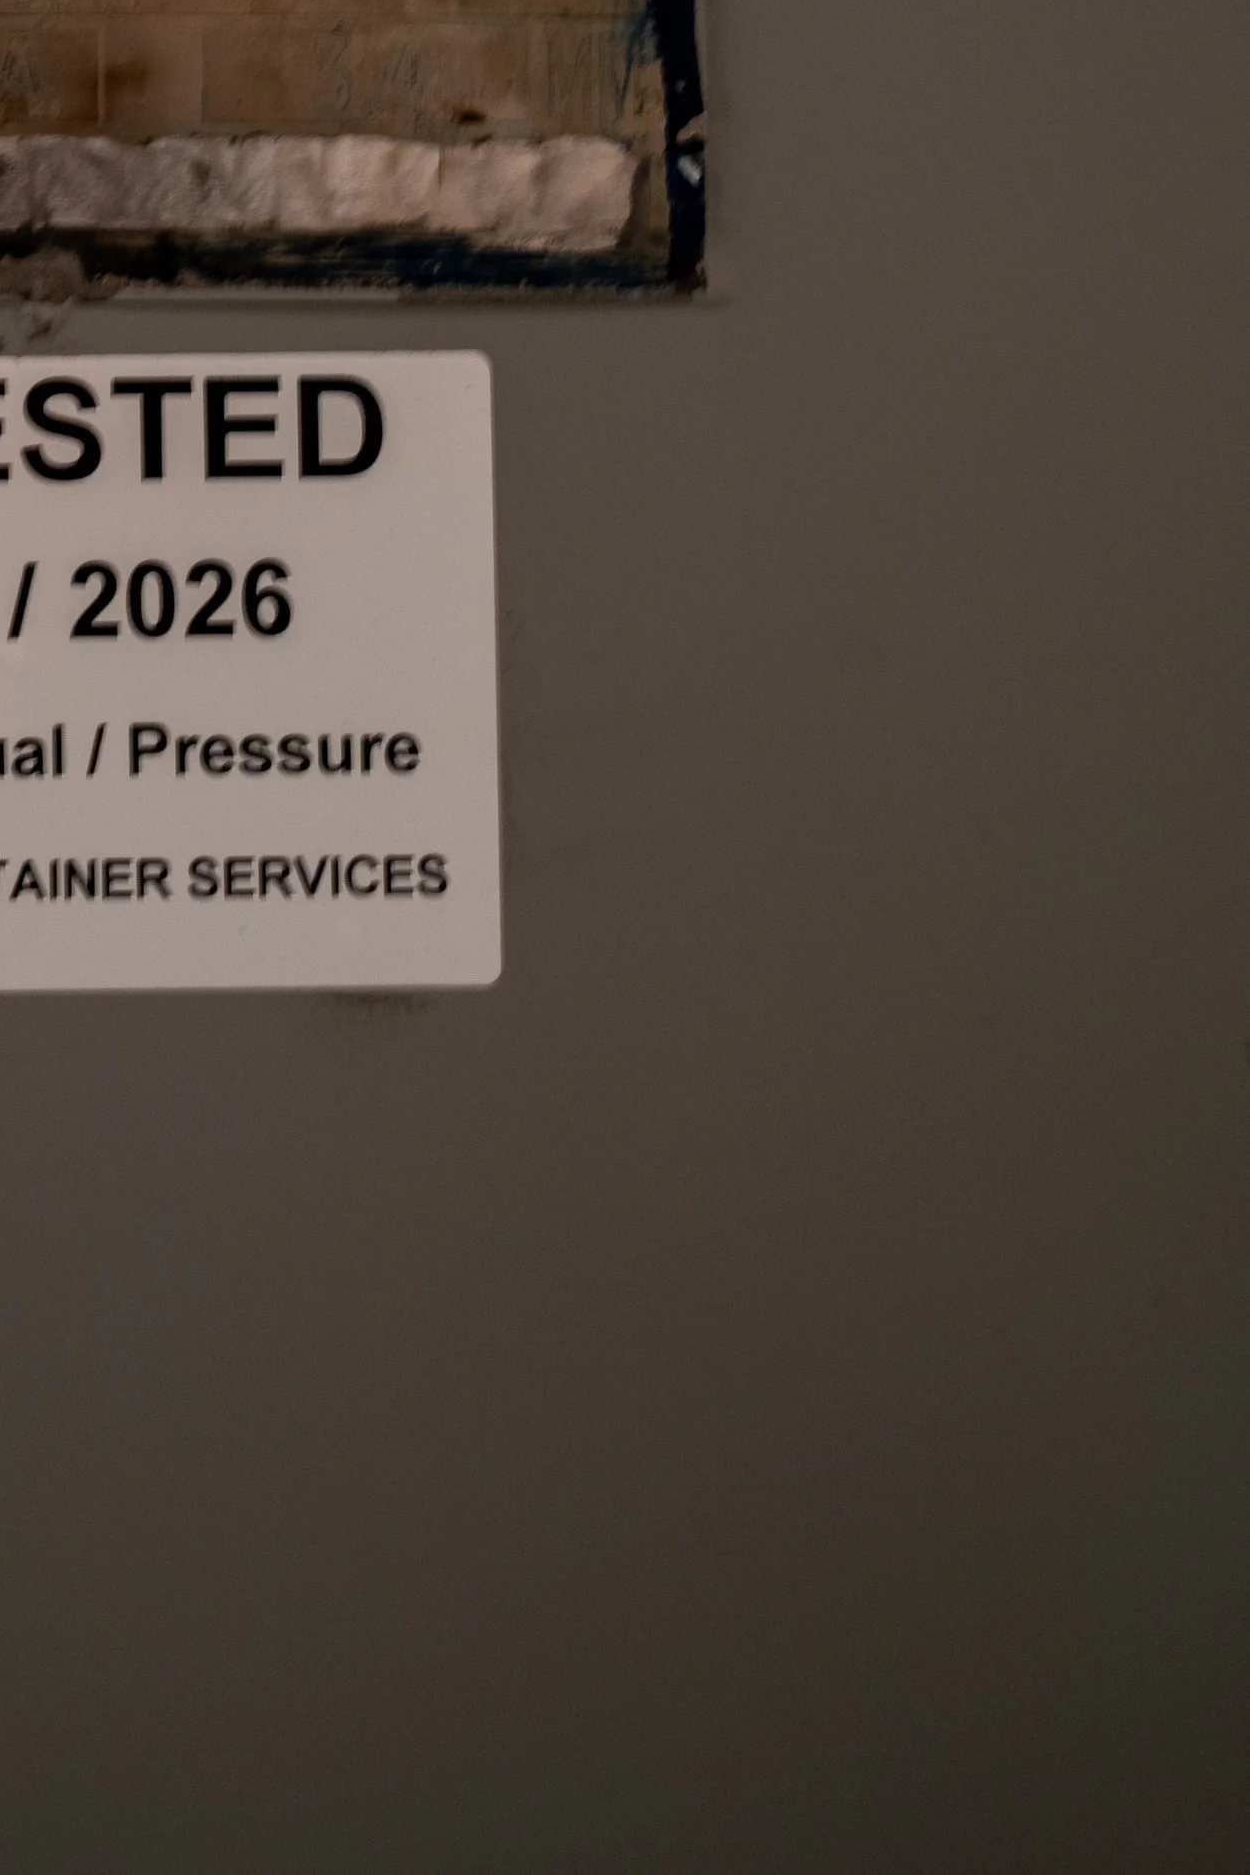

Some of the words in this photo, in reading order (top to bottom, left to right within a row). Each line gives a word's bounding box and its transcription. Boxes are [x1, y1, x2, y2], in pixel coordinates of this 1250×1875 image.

[6, 563, 39, 639] /
[70, 559, 292, 639] 2026
[86, 725, 108, 776] /
[127, 722, 423, 776] Pressure
[186, 854, 450, 899] SERVICES
